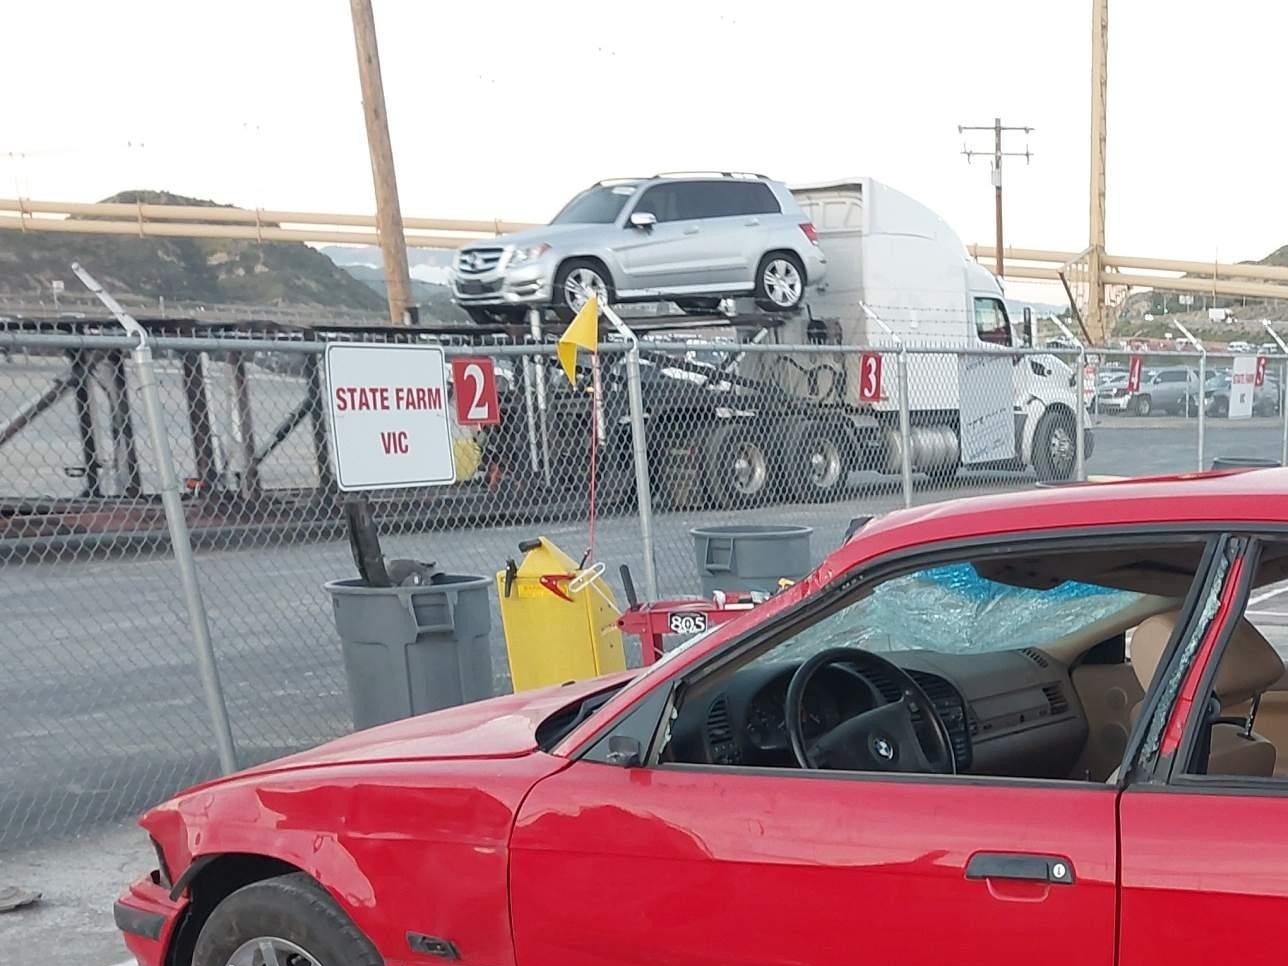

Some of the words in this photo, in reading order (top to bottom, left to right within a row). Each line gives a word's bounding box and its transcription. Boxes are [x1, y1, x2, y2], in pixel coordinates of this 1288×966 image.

[863, 356, 877, 397] 3
[1131, 359, 1140, 390] 4
[335, 387, 390, 411] STATE
[395, 388, 442, 410] FARM
[463, 363, 489, 420] 2
[381, 431, 409, 454] VIC
[671, 616, 706, 632] 805
